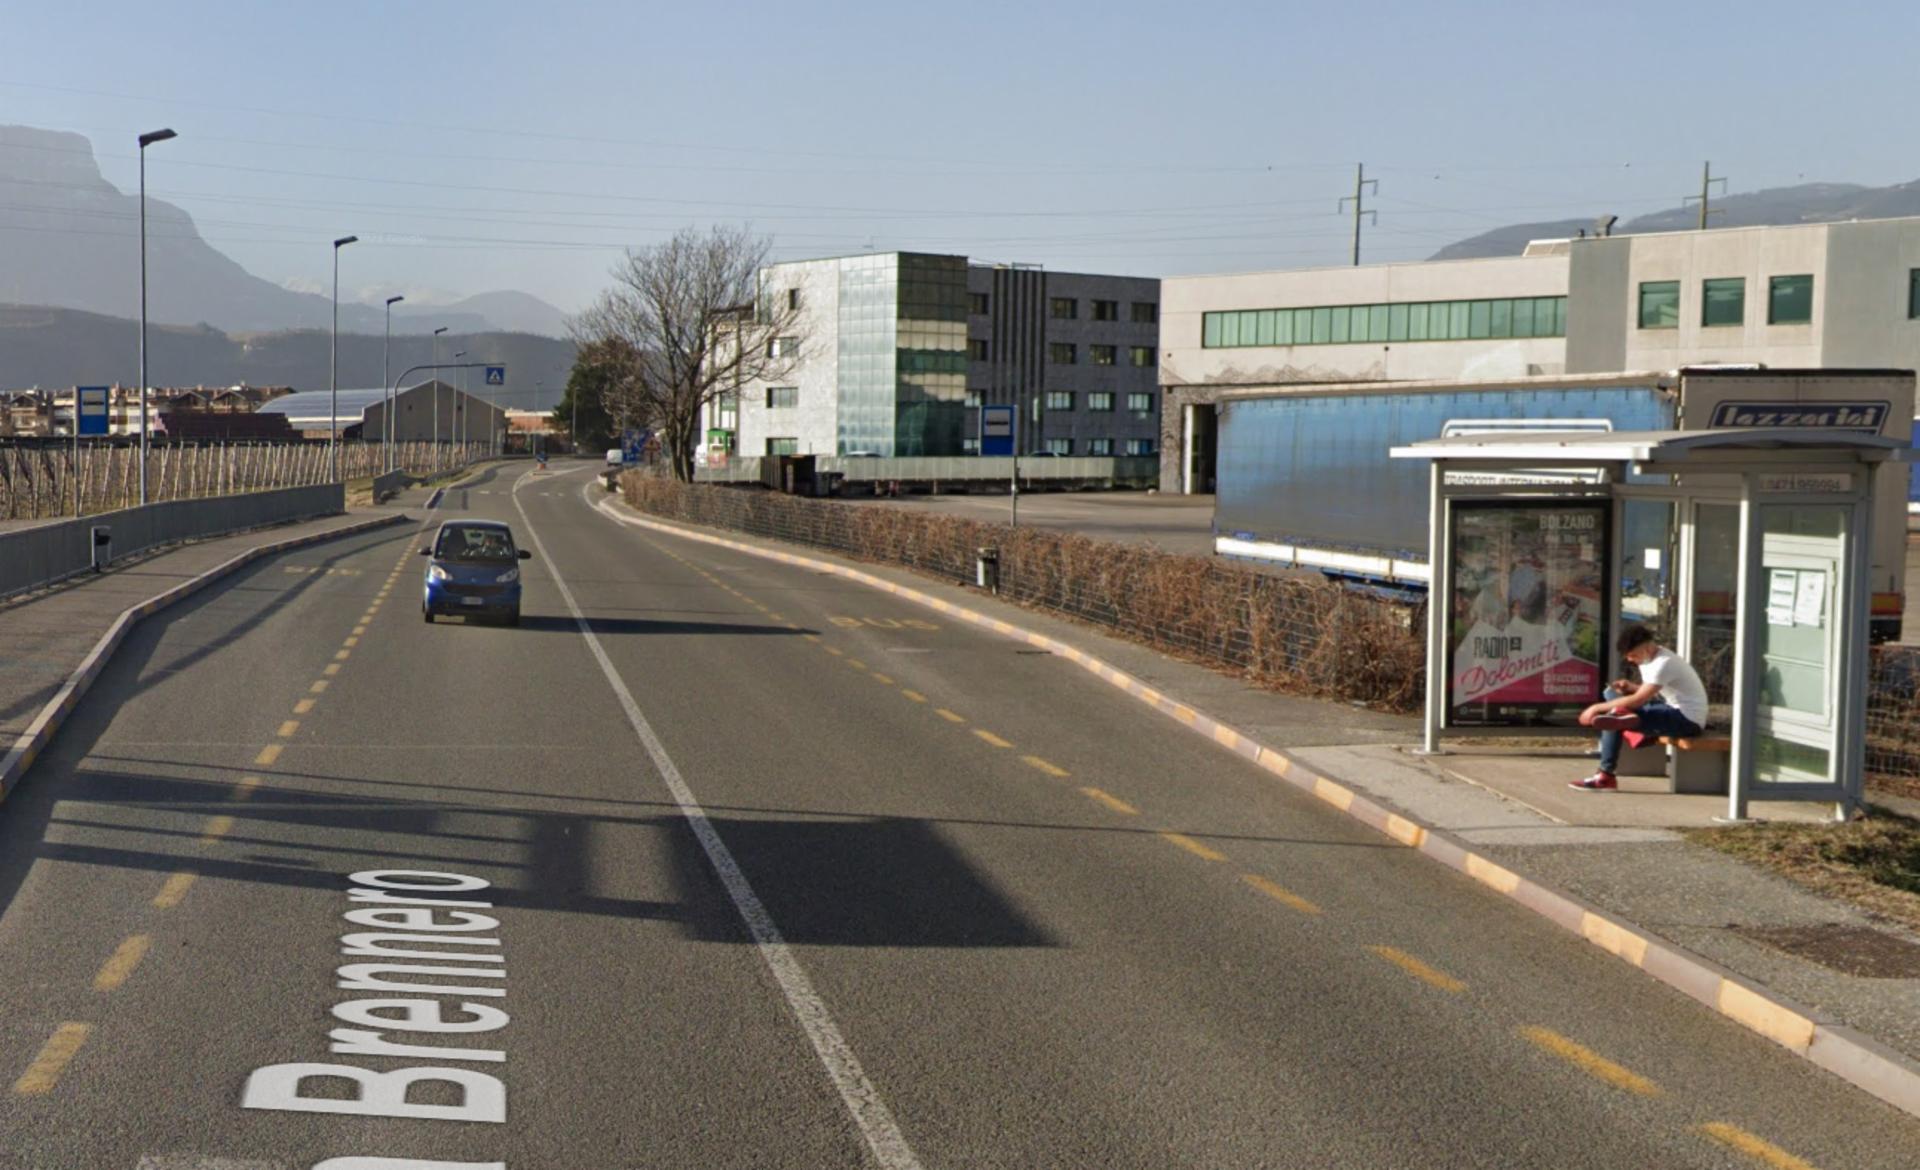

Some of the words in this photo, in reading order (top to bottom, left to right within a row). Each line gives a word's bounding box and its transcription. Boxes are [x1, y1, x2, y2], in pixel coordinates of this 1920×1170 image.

[1540, 514, 1594, 529] BOLZANO
[1473, 635, 1508, 659] RADIO
[1459, 639, 1559, 696] Dolomiti
